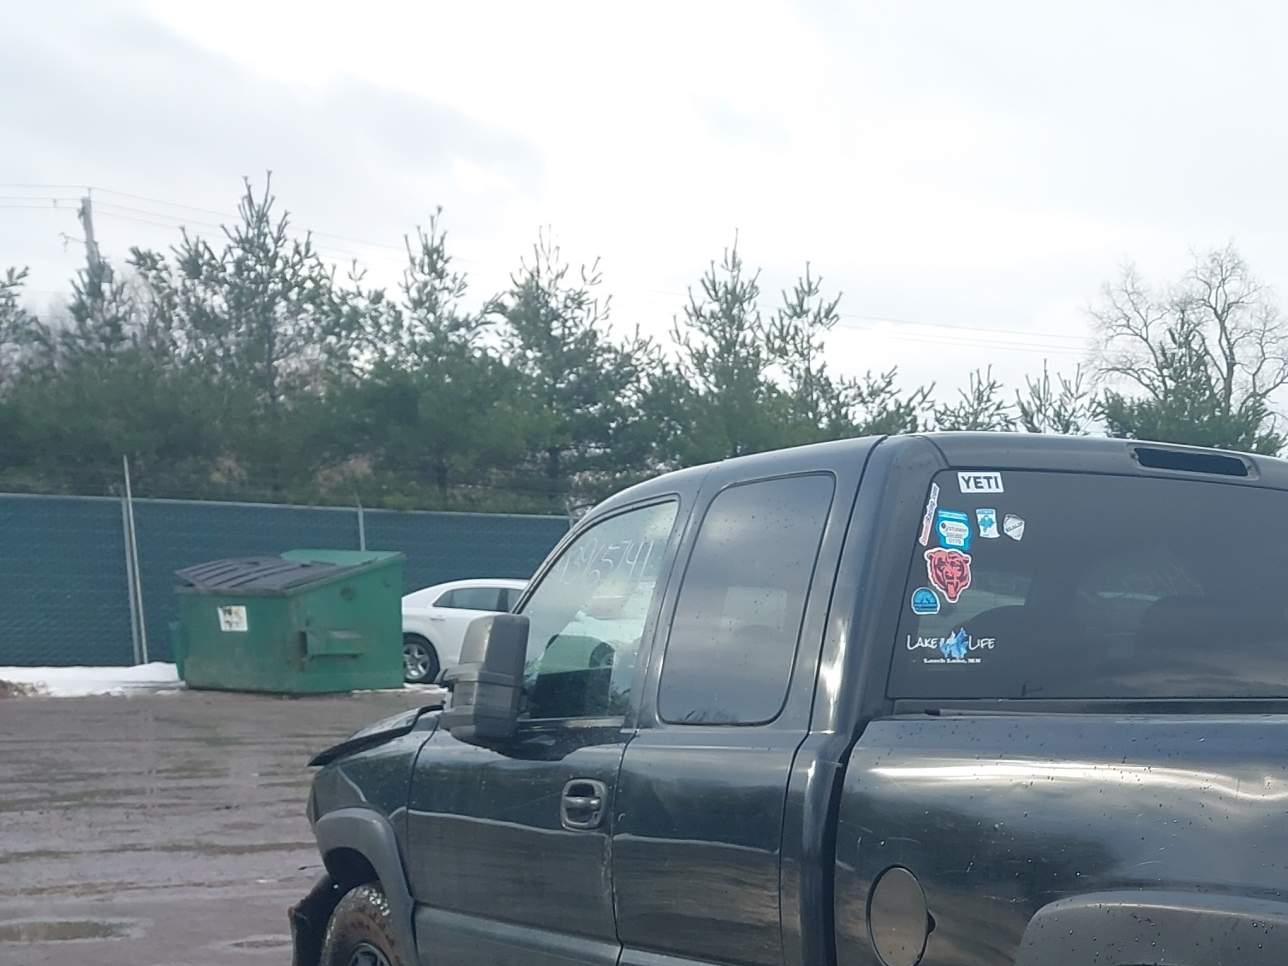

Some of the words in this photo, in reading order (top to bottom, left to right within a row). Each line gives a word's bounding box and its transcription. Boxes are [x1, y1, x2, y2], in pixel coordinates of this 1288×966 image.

[961, 475, 1000, 490] YETI
[906, 634, 938, 650] LAKE
[968, 634, 996, 650] LIFE
